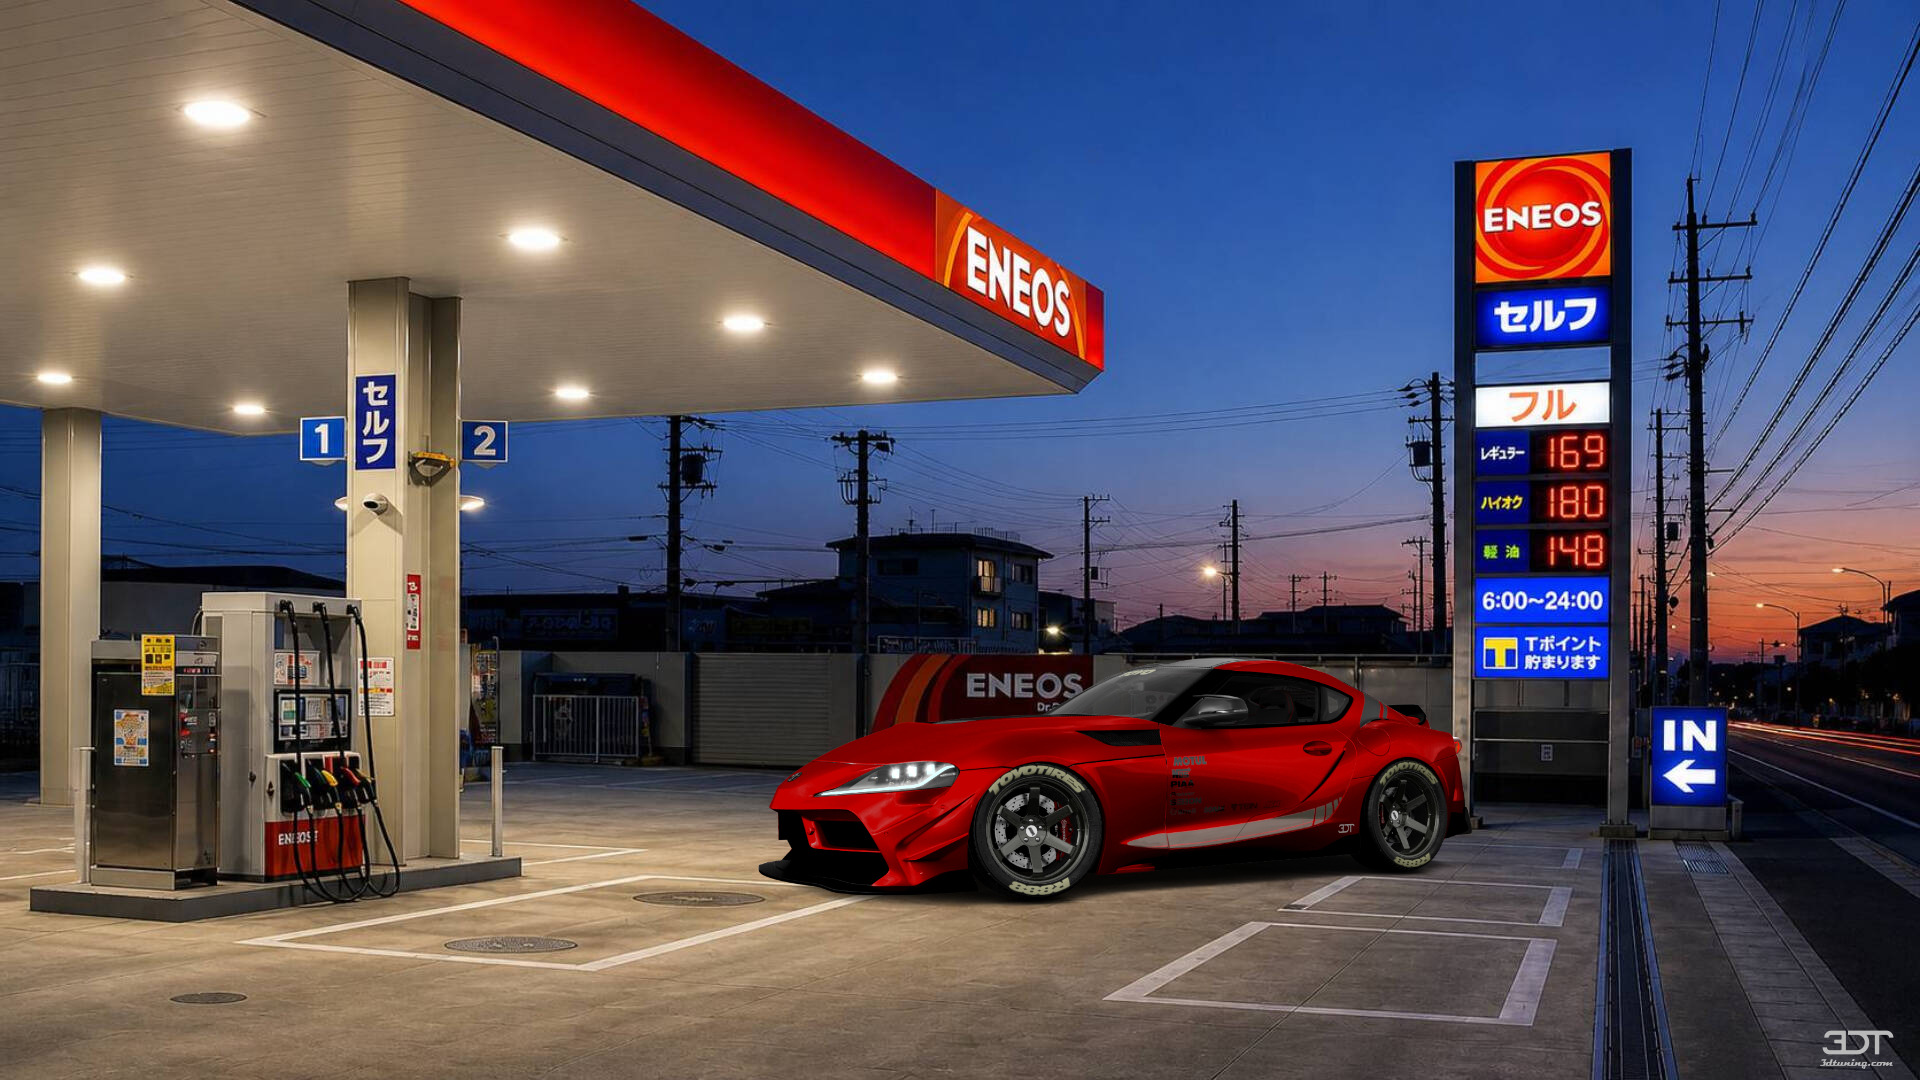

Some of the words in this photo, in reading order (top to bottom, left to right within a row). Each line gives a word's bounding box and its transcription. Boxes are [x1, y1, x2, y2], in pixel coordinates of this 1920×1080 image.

[1483, 201, 1602, 234] ENEOS
[967, 225, 1071, 338] ENEOS
[1493, 296, 1597, 334] セルフ
[1508, 388, 1577, 423] フル
[314, 423, 329, 454] 1
[361, 380, 390, 465] セルフ
[473, 425, 497, 456] 2
[1480, 446, 1525, 461] レギュラー
[1549, 435, 1604, 468] 169
[1480, 495, 1524, 510] ハイオク
[1549, 485, 1604, 518] 180
[1549, 534, 1604, 567] 148
[1525, 635, 1601, 653] Tポイント
[1524, 653, 1601, 671] 貯まります
[966, 672, 1084, 700] ENEOS
[1663, 719, 1717, 752] IN
[1173, 755, 1207, 767] MOTUL
[1171, 780, 1194, 788] PIAA
